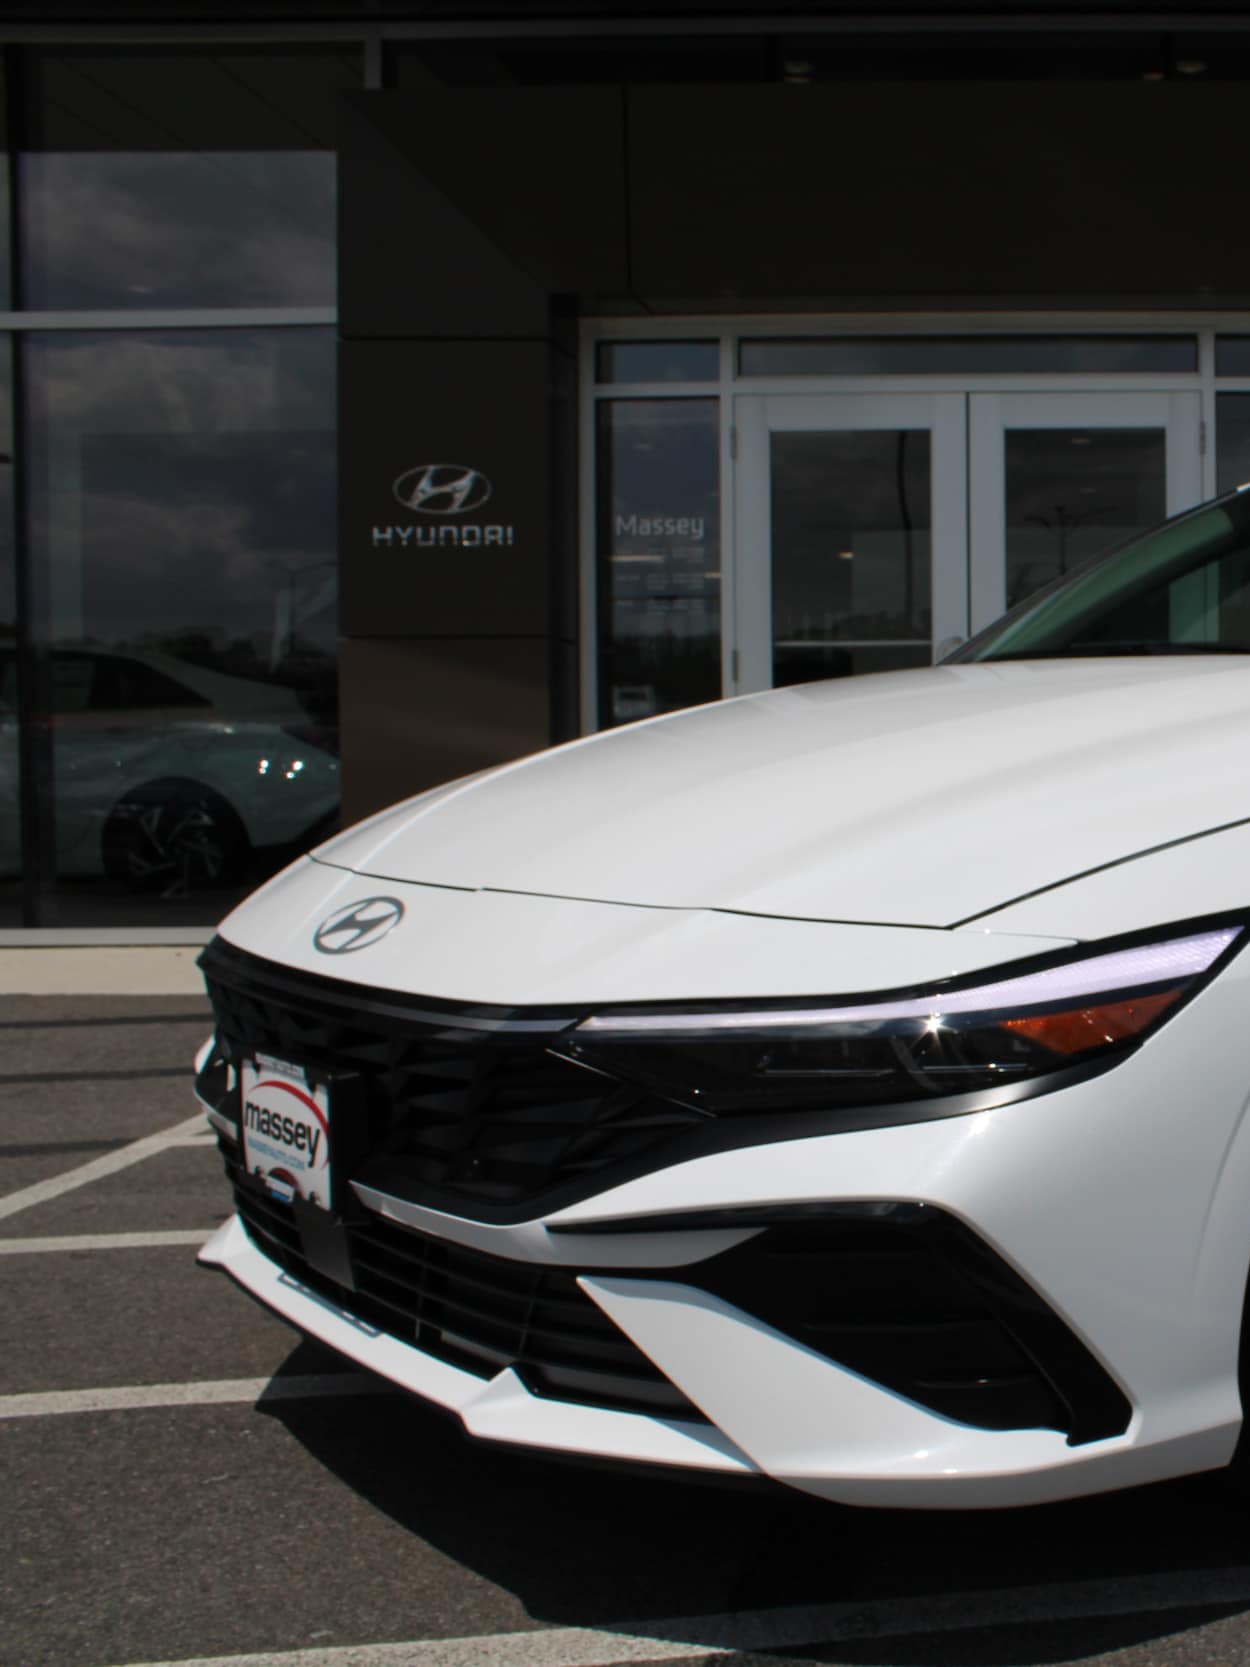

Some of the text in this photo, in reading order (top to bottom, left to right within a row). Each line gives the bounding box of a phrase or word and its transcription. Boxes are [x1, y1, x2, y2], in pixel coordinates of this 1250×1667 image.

[371, 525, 514, 548] HYUNDAI
[615, 515, 704, 539] Massey
[244, 1100, 320, 1168] massey
